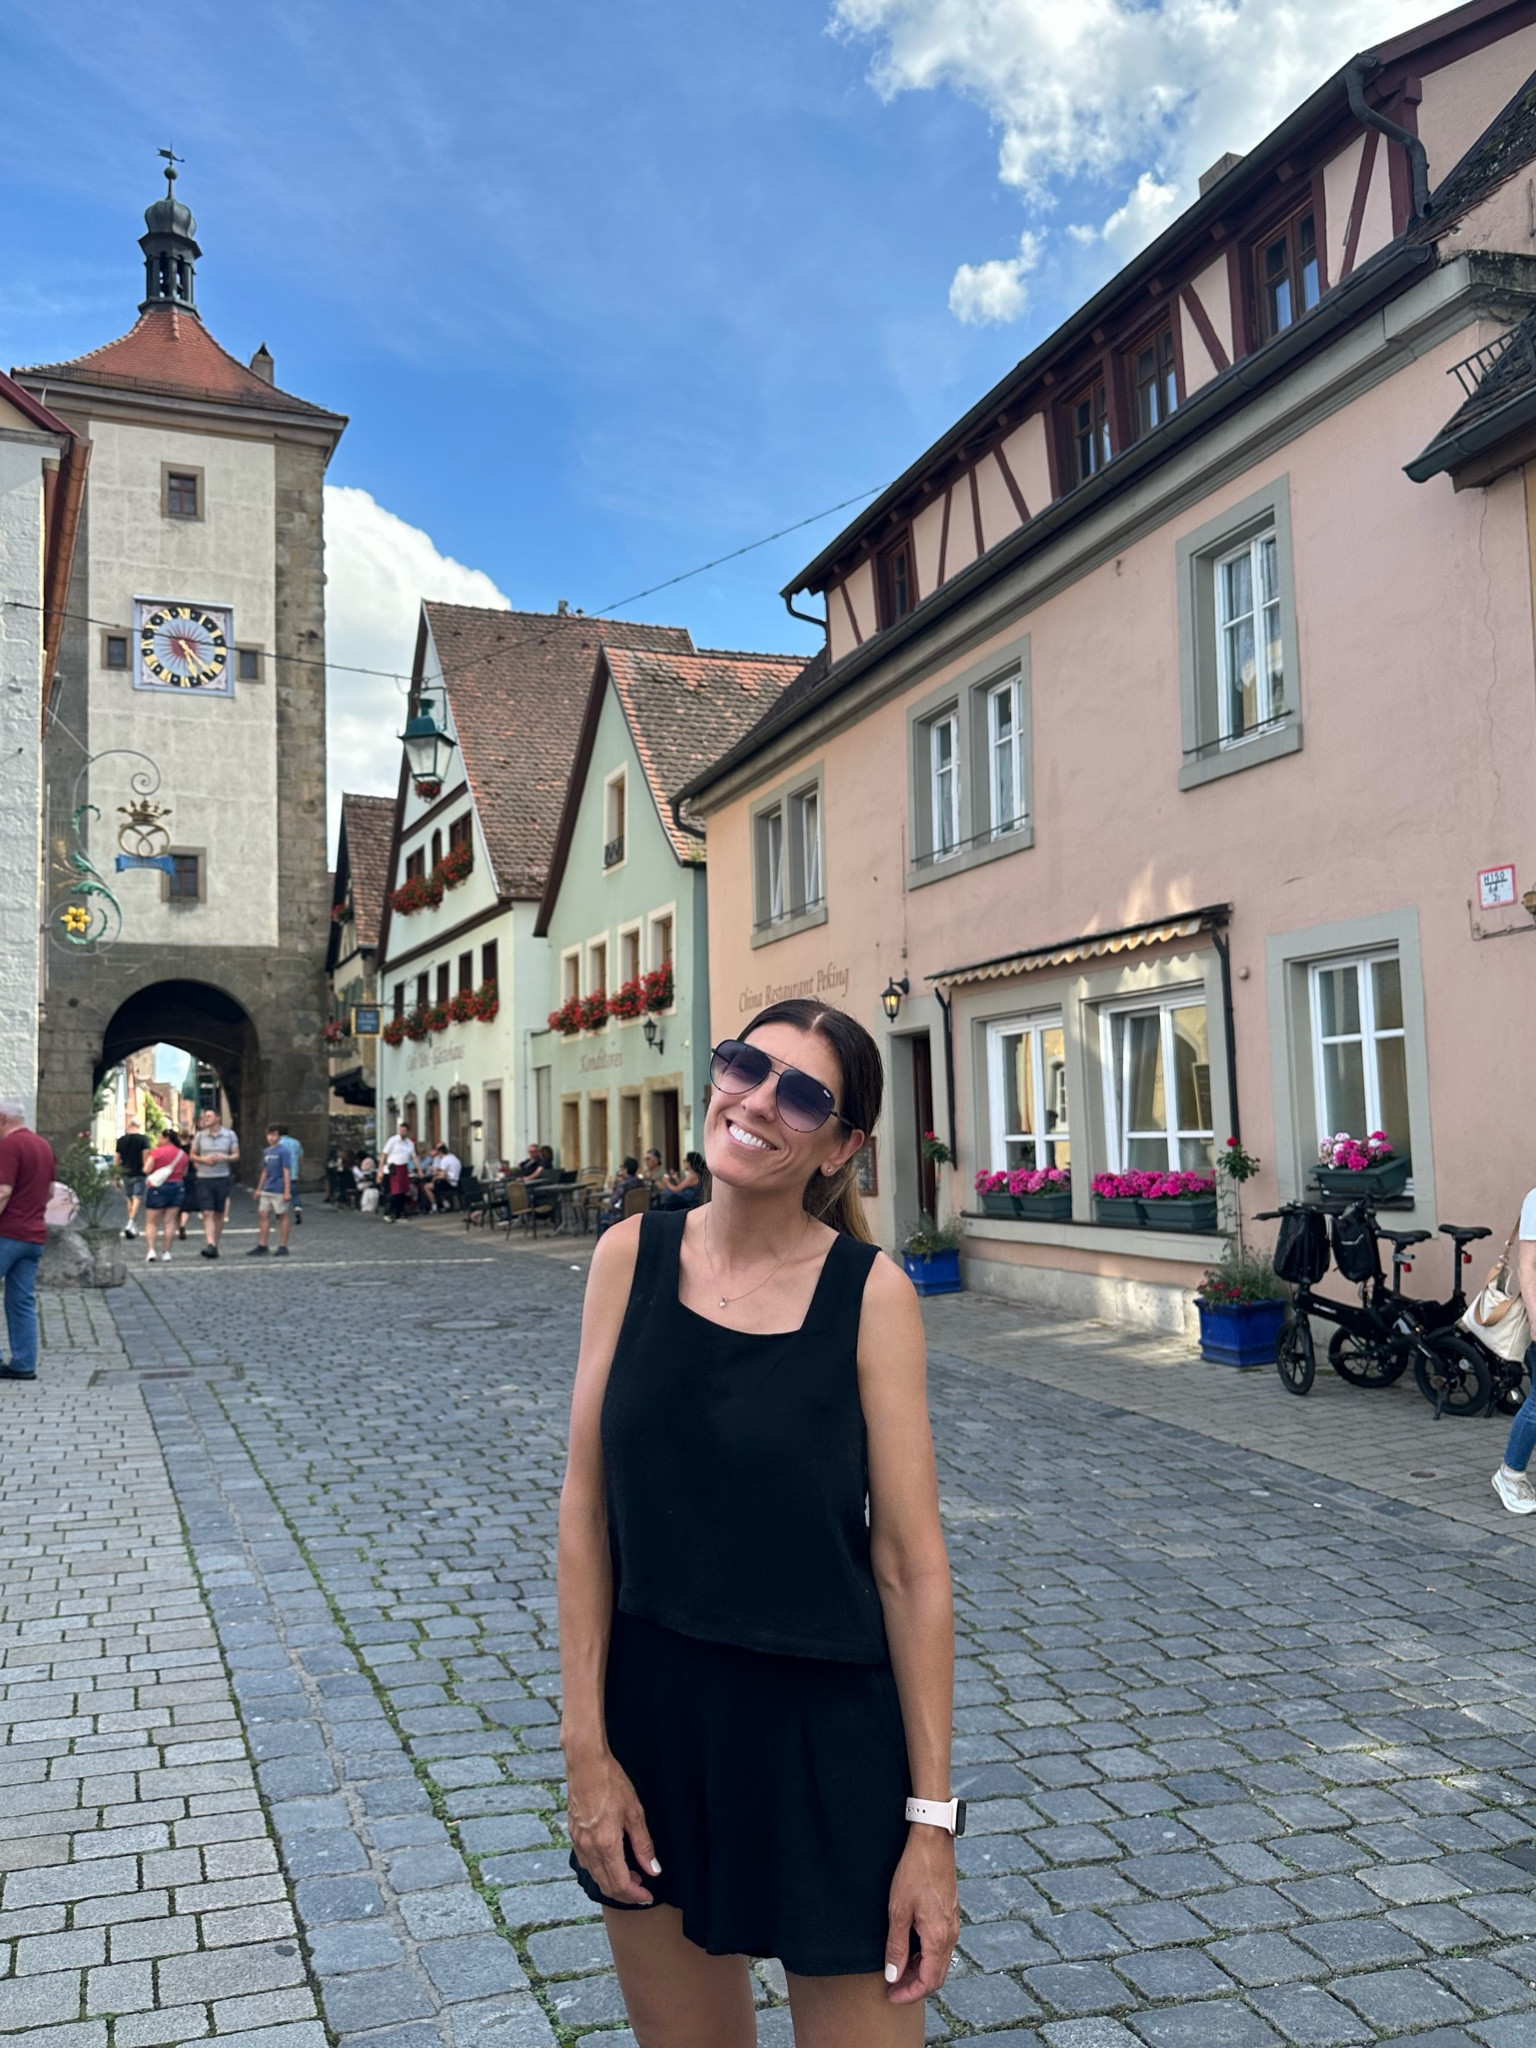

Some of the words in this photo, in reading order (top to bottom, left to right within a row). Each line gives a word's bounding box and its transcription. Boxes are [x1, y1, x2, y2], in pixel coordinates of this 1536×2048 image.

[739, 986, 763, 1012] China
[765, 977, 814, 1006] Restaurant
[816, 962, 849, 998] Peking
